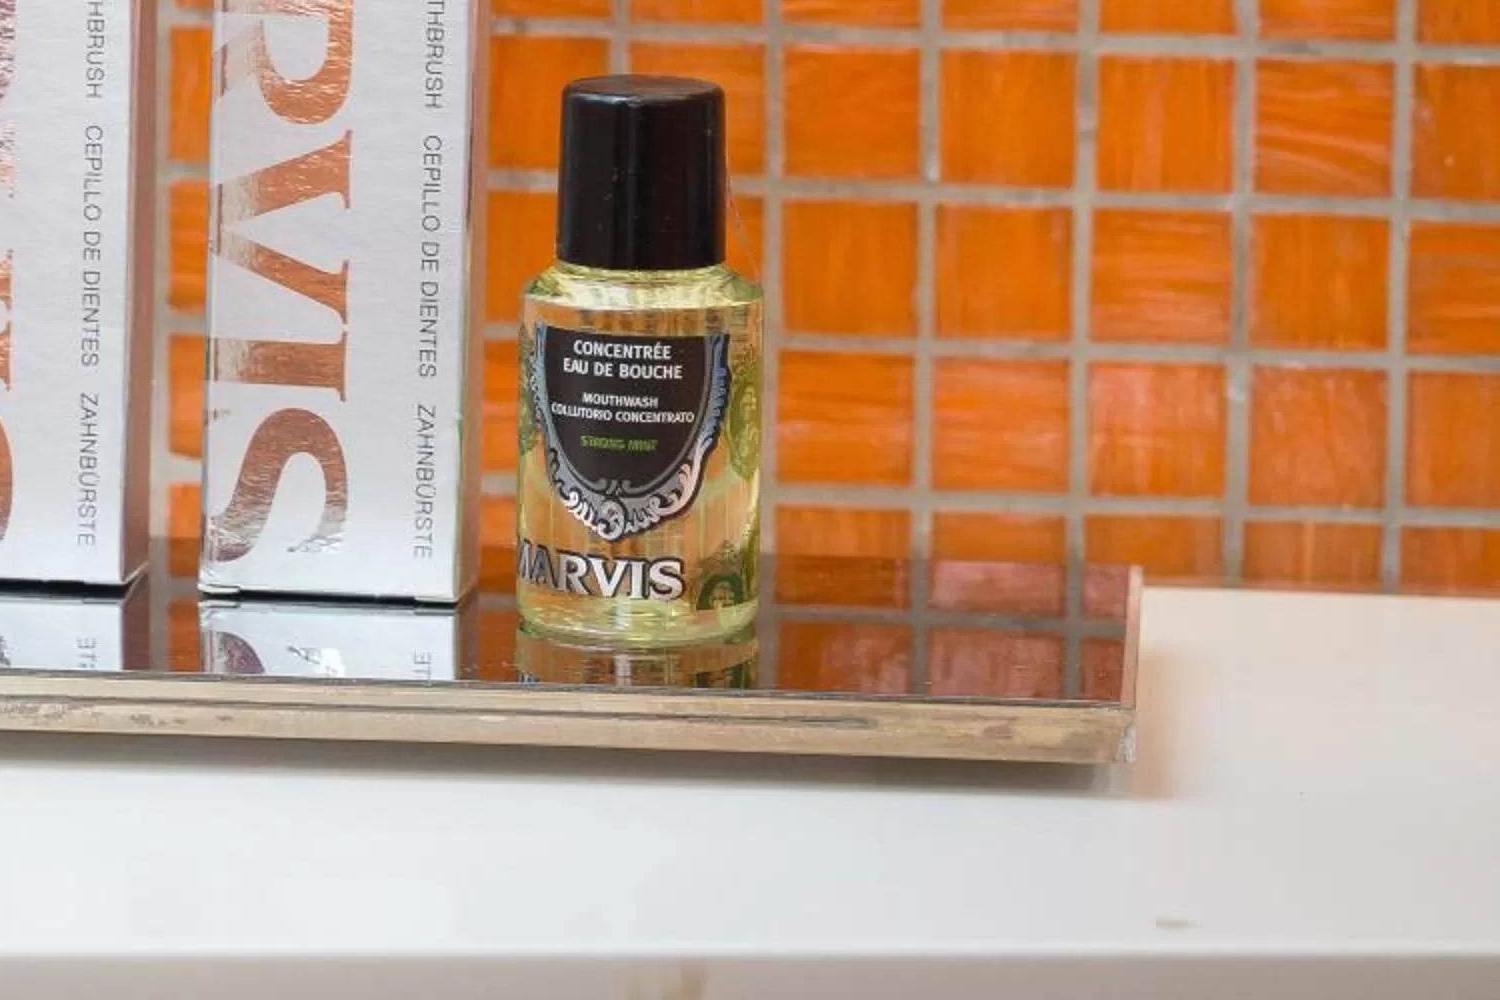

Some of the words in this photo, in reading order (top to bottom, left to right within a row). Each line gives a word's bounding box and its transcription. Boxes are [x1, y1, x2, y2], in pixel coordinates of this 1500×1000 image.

[83, 124, 104, 222] CEPILLO
[421, 134, 443, 232] CEPILLO
[83, 231, 102, 261] DE
[420, 242, 440, 272] DE
[80, 270, 101, 368] DIENTES
[418, 281, 439, 378] DIENTES
[573, 340, 672, 360] CONCENTRÉE
[563, 358, 588, 375] EAU
[594, 362, 613, 377] DE
[619, 363, 683, 379] BOUCHE
[582, 392, 659, 408] MOUTHWASH
[551, 401, 612, 421] COLLUTORIO
[615, 410, 695, 424] CONCENTRATO
[77, 392, 100, 547] ZAHNBÜRSTE
[413, 403, 436, 559] ZAHNBÜRSTE
